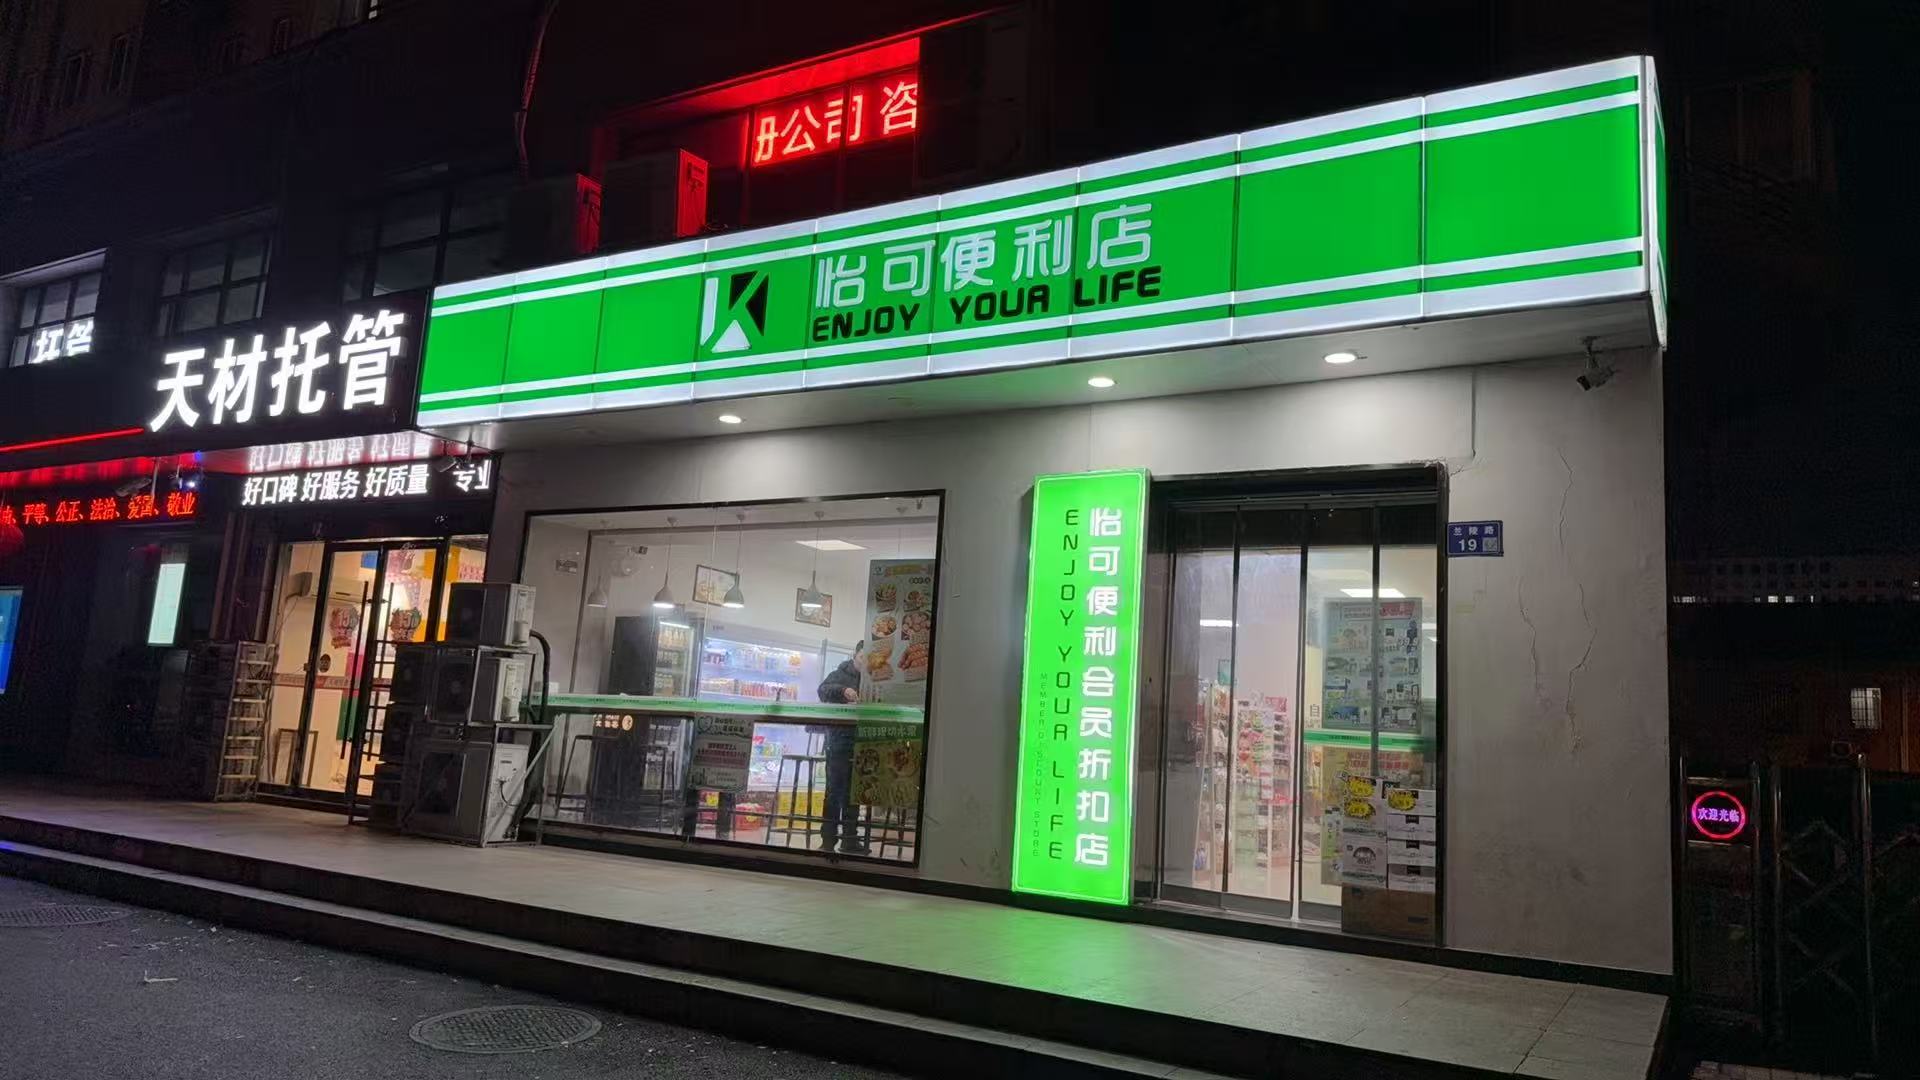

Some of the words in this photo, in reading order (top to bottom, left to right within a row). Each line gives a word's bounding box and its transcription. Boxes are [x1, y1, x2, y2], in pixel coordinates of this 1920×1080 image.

[816, 203, 1152, 308] 怡可便利店
[812, 303, 921, 342] ENJOY
[1074, 265, 1162, 308] LIFE
[150, 309, 405, 433] 天材托管
[242, 474, 299, 506] 好口碑
[300, 469, 361, 502] 好服务
[364, 464, 430, 498] 好质量
[1059, 508, 1080, 627] ENJOY
[1453, 525, 1494, 536] 兰陵路
[1458, 538, 1478, 552] 19
[1073, 506, 1124, 868] 怡可便利会员折扣店
[1048, 759, 1066, 861] LIFE
[1697, 807, 1740, 823] 欢迎光临
